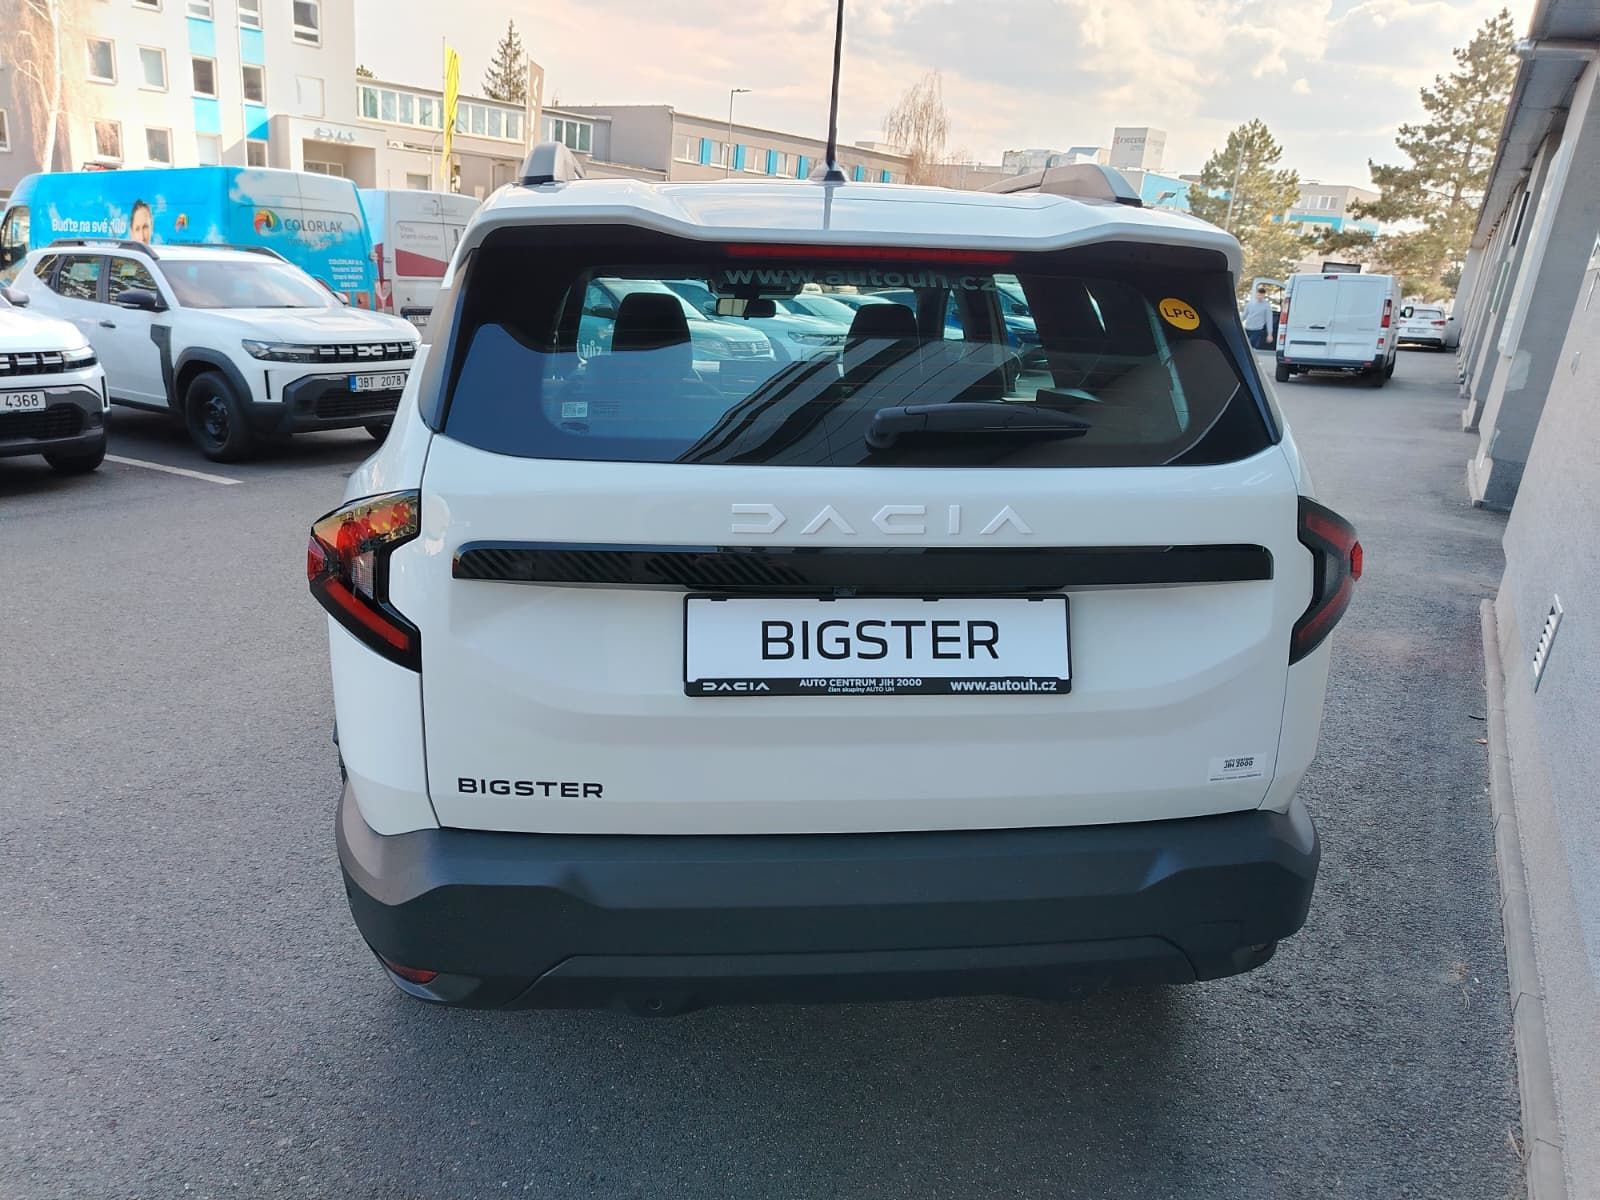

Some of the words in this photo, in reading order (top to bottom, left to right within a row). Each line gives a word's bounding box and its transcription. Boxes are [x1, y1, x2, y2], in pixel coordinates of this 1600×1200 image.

[79, 221, 90, 232] na
[284, 218, 343, 232] COLORLAK
[724, 269, 999, 291] www.autouh.cz
[1163, 307, 1195, 320] LPG
[358, 376, 374, 388] 3BT
[381, 375, 402, 387] 2078
[5, 393, 39, 408] 4368
[731, 503, 1033, 535] DACIA
[761, 619, 1000, 661] BIGSTER
[702, 682, 770, 691] DACIA
[799, 679, 827, 688] AUTO
[829, 678, 877, 687] CENTRUM
[879, 678, 894, 687] JIH
[896, 678, 922, 687] 2000
[950, 679, 1057, 691] www.autouh.cz
[457, 777, 604, 799] BIGSTER
